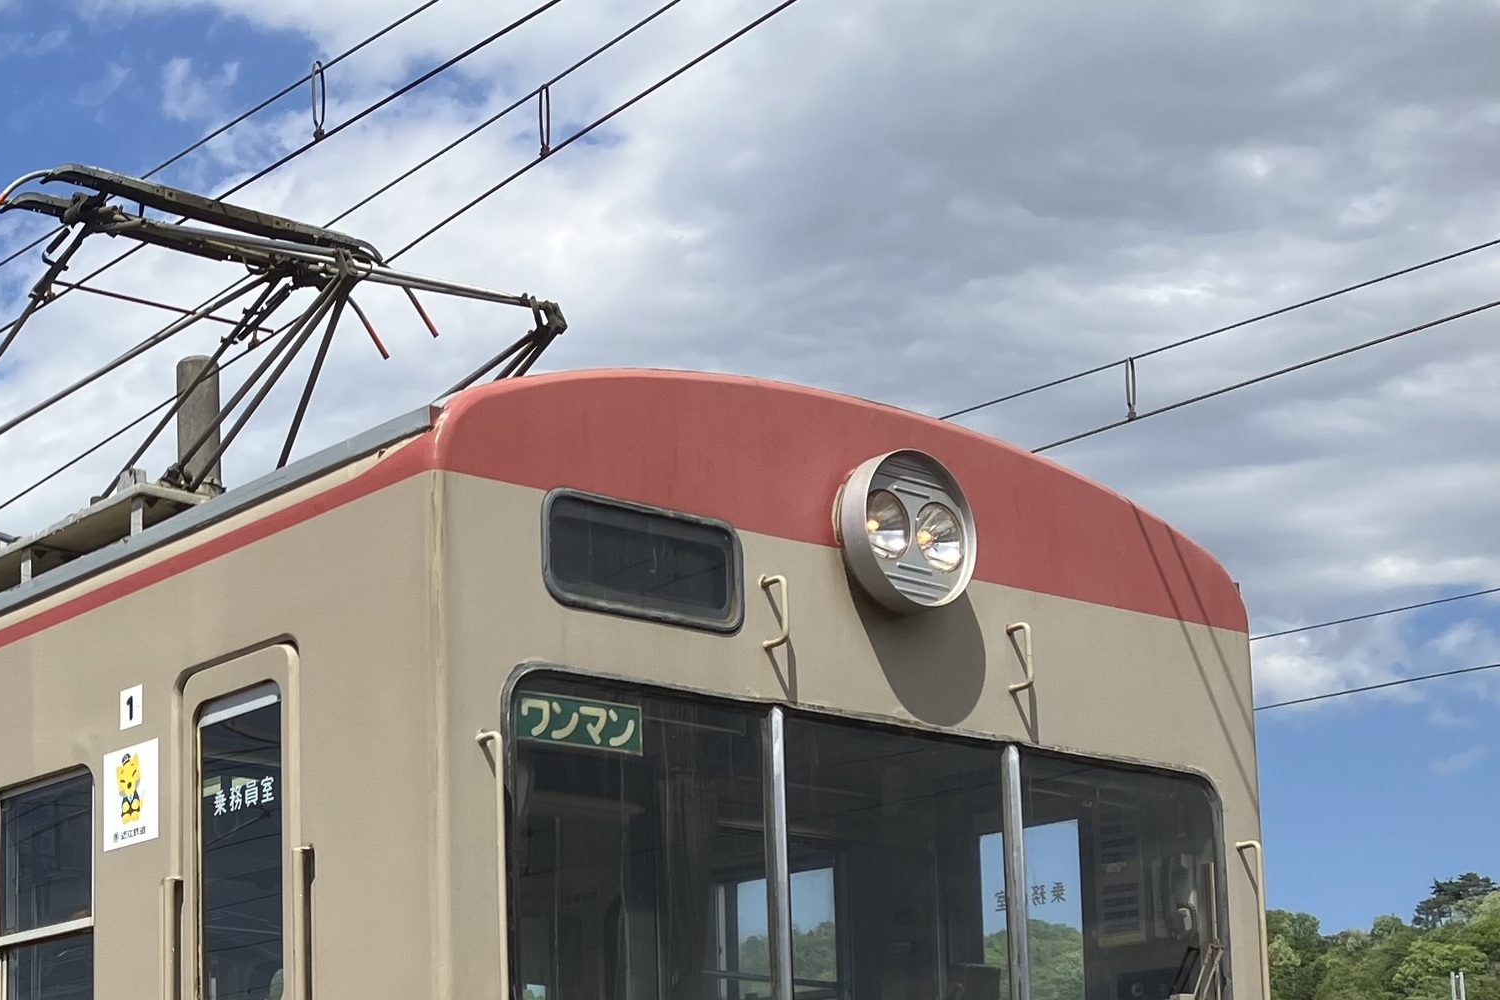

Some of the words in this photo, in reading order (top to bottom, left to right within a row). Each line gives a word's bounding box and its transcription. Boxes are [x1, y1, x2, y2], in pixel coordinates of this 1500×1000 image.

[126, 695, 134, 721] 1
[520, 697, 635, 747] ワンマン
[213, 776, 275, 817] 乗務員室
